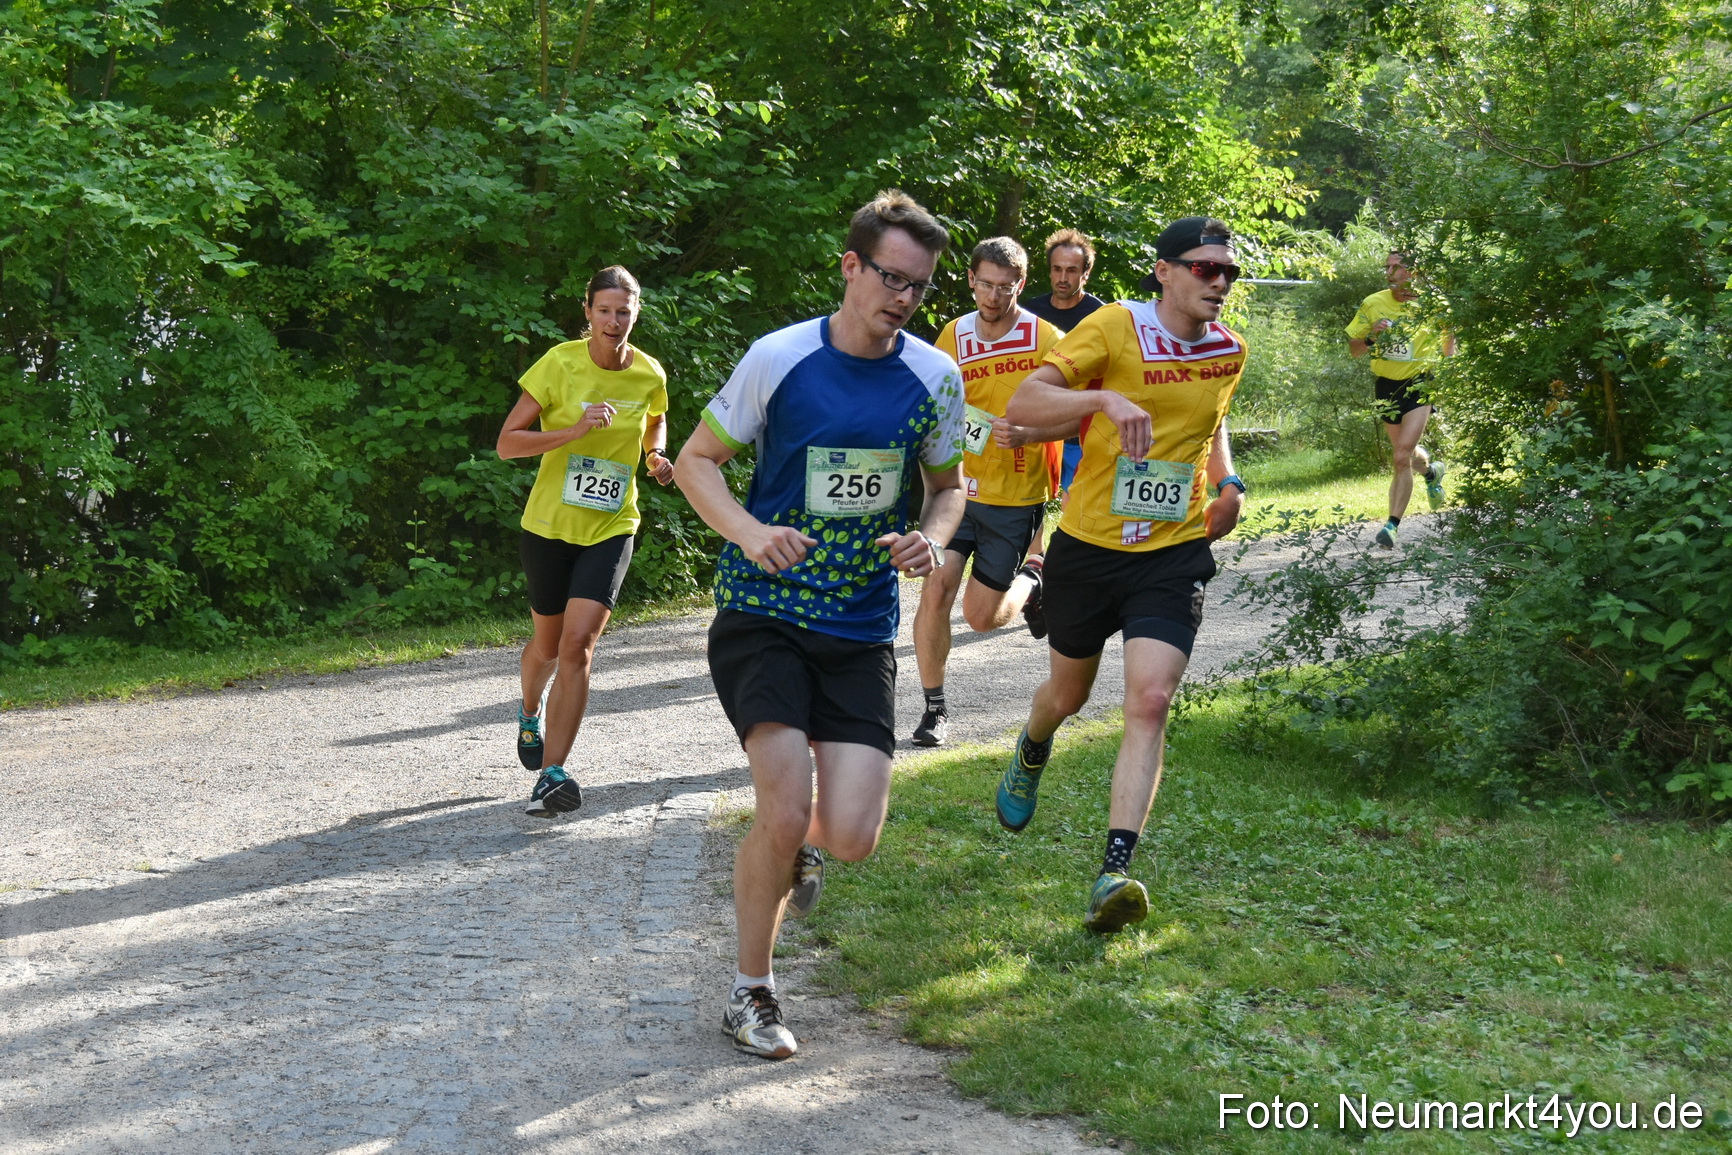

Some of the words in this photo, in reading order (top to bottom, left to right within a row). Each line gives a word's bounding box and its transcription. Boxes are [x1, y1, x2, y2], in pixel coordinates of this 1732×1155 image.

[962, 365, 990, 382] MAX
[994, 357, 1040, 374] BÖGL
[1143, 368, 1193, 385] MAX
[1199, 362, 1240, 380] BÖGL
[574, 474, 620, 498] 1258
[827, 474, 882, 498] 256
[1125, 479, 1181, 504] 1603
[1123, 500, 1158, 510] Jonuscheit
